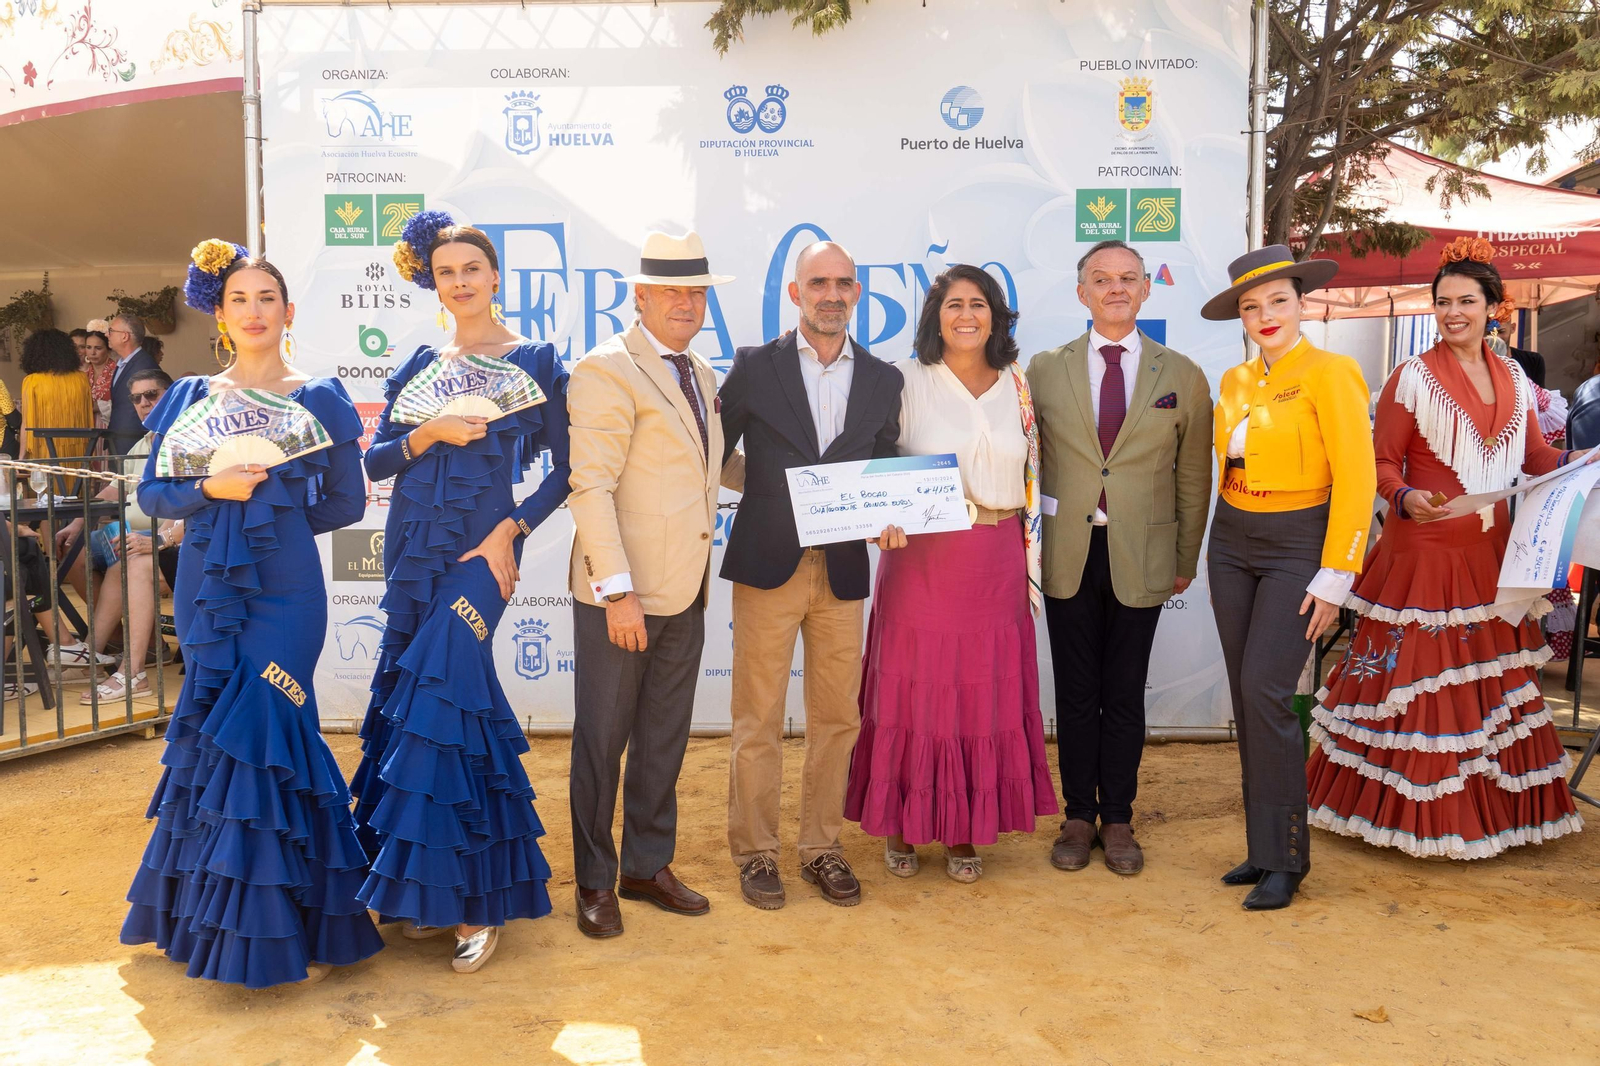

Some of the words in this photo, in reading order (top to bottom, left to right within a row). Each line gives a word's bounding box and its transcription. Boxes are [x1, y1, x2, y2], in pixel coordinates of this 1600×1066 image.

[1080, 60, 1131, 71] PUEBLO
[1135, 58, 1198, 70] INVITADO:
[322, 69, 388, 80] ORGANIZA:
[490, 68, 570, 79] COLABORAN:
[360, 112, 413, 141] AHE
[547, 122, 600, 131] Ayuntamiento
[602, 122, 612, 130] de
[549, 133, 614, 147] HUELVA
[699, 138, 756, 149] DIPUTACIÓN
[759, 139, 815, 148] PROVINCIAL
[900, 137, 949, 150] Puerto
[952, 136, 971, 150] de
[974, 135, 1024, 149] Huelva
[321, 150, 359, 158] Asociación
[361, 150, 386, 158] Huelva
[388, 150, 418, 158] Ecuestre
[744, 149, 779, 157] HUELVA
[1098, 166, 1182, 177] PATROCINAN:
[326, 173, 406, 183] PATROCINAN:
[1135, 197, 1176, 233] 25
[341, 293, 411, 308] BLISS
[432, 370, 488, 398] RIVES
[206, 407, 270, 438] RIVES
[347, 561, 359, 570] EL
[332, 595, 384, 605] ORGANI
[508, 597, 572, 607] OLABORAN
[450, 595, 489, 643] RIVES
[705, 669, 733, 677] DIPUT
[260, 661, 307, 708] RIVES
